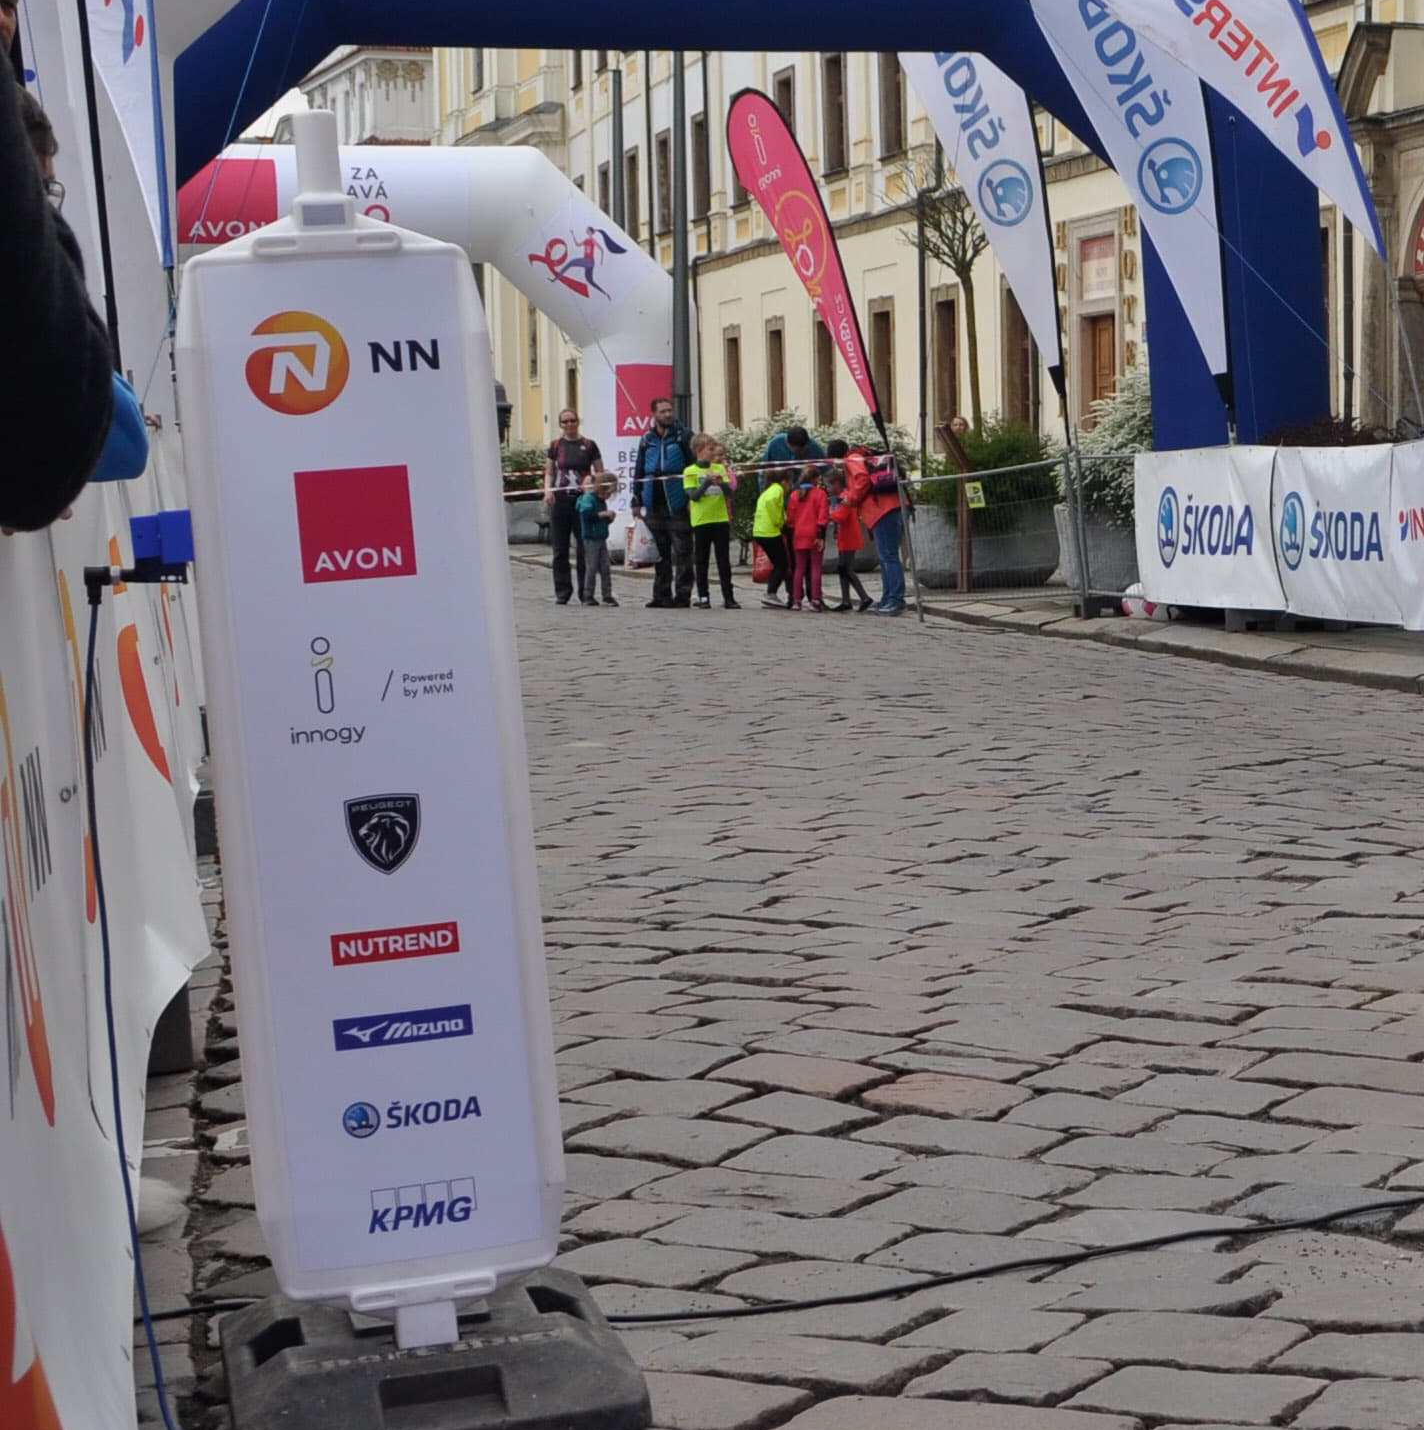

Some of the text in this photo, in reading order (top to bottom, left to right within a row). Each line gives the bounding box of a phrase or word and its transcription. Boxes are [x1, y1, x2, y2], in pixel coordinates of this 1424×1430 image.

[351, 167, 379, 180] ZA
[346, 181, 388, 199] AVÁ
[367, 338, 441, 374] NN
[1181, 494, 1254, 556] ŠKODA
[1309, 500, 1384, 562] ŠKODA
[314, 545, 403, 572] AVON
[402, 669, 454, 684] Powered
[403, 683, 454, 699] by MVM
[289, 725, 366, 745] innogy
[351, 800, 412, 813] PEUGEOT
[338, 928, 453, 958] NUTREND
[386, 1095, 482, 1130] ŠKODA
[368, 1195, 472, 1234] KPMG
